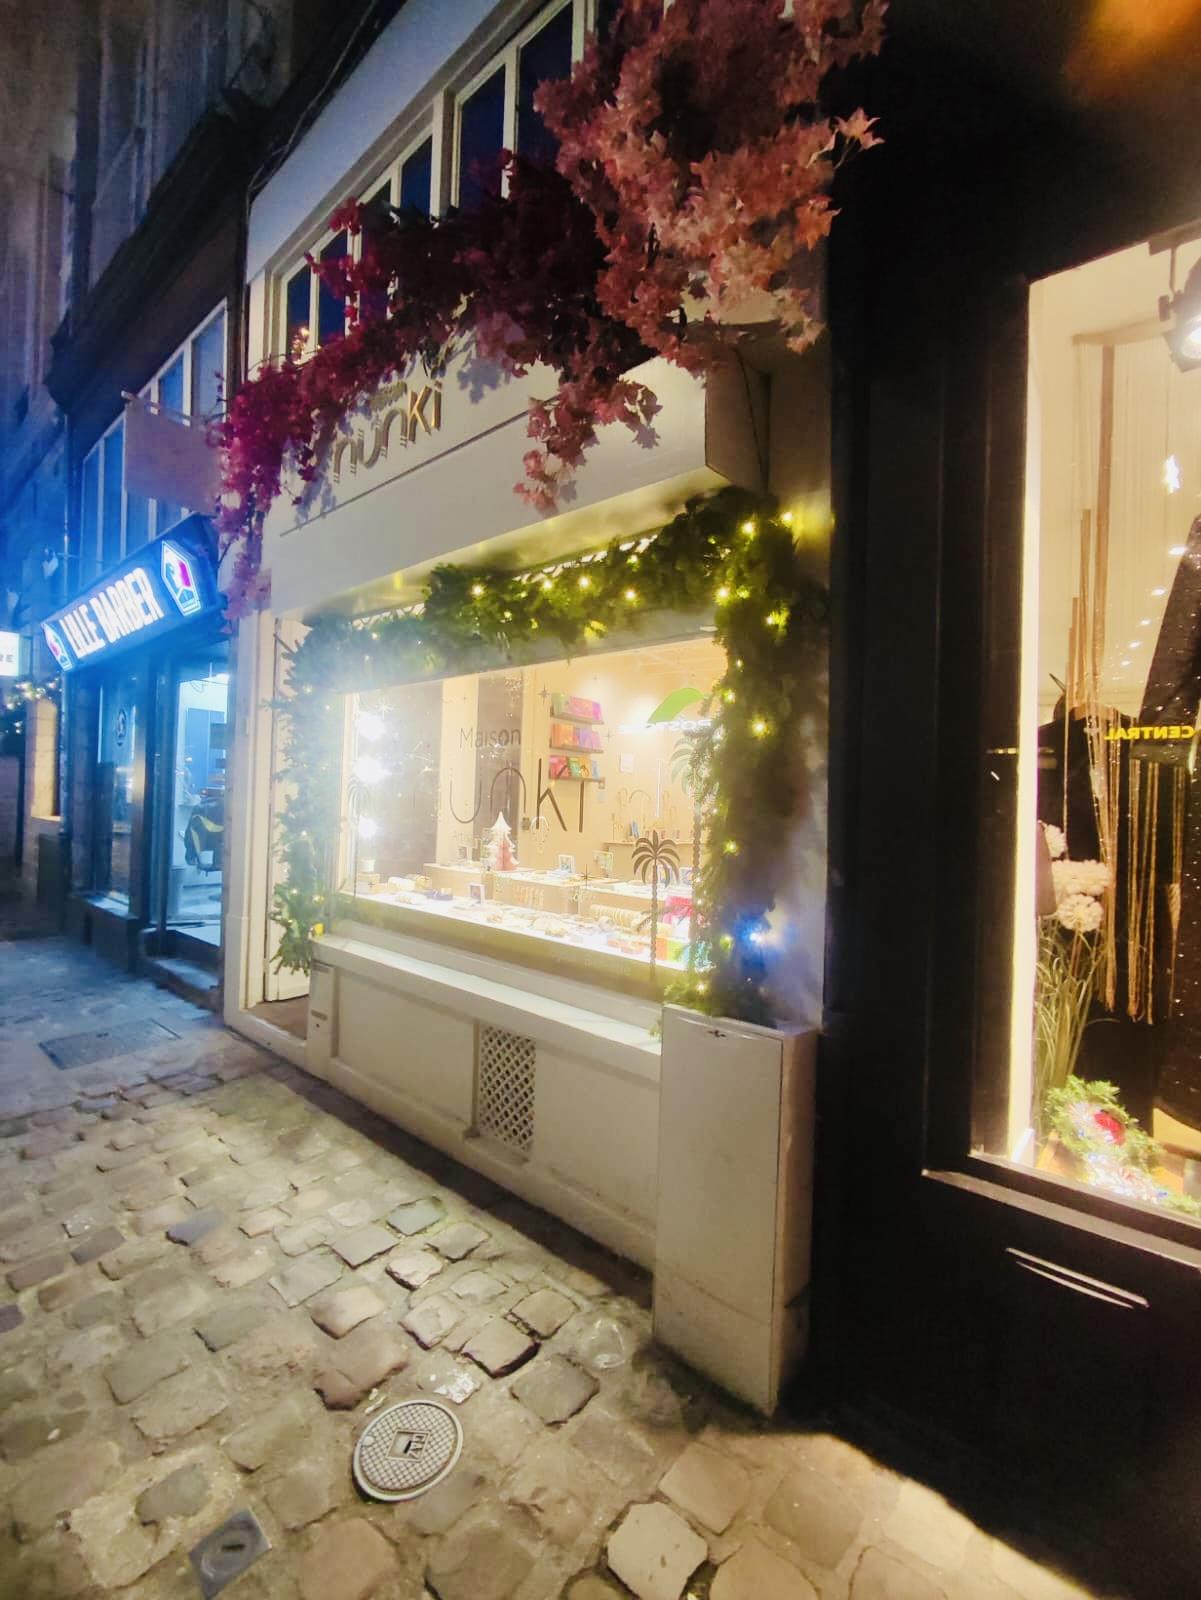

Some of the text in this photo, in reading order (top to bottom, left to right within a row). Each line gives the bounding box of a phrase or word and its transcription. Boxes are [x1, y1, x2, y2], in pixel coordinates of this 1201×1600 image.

[58, 567, 165, 659] LILLE BARBER
[458, 726, 522, 749] Maison
